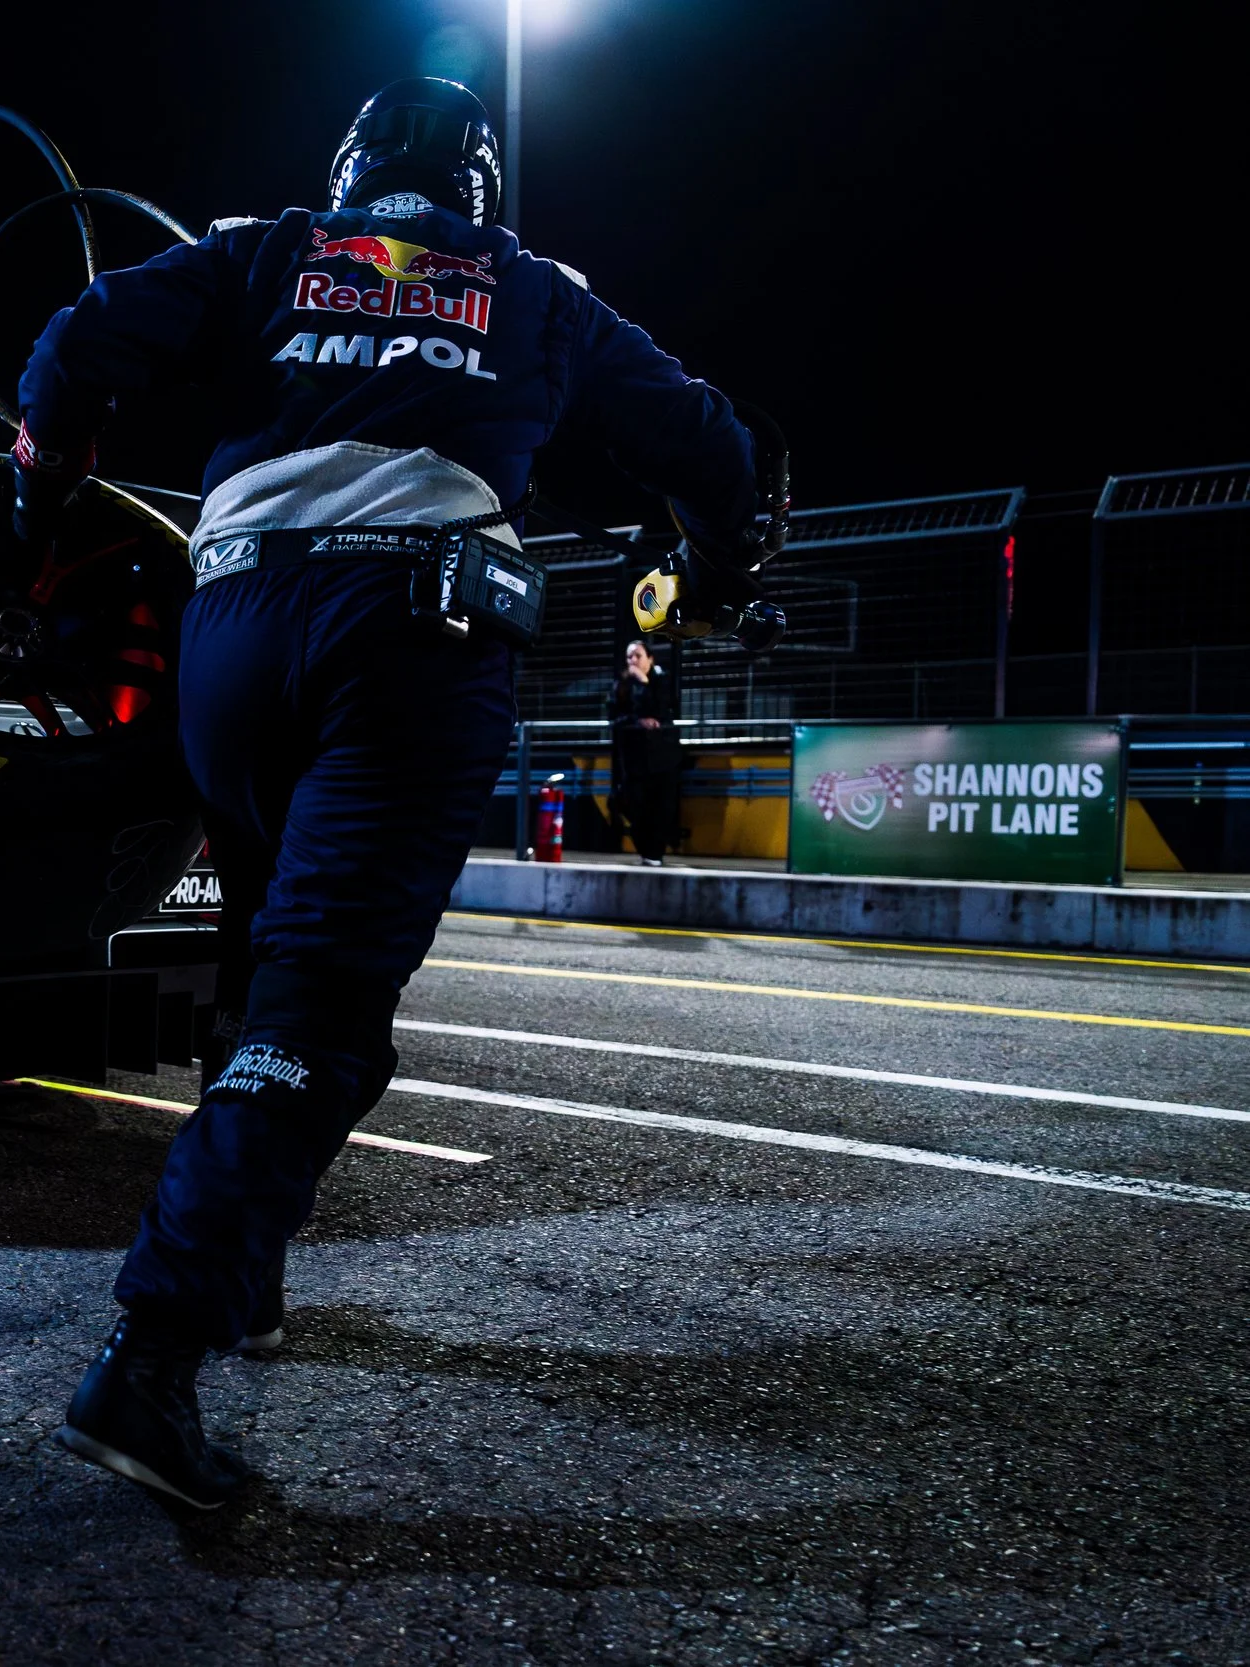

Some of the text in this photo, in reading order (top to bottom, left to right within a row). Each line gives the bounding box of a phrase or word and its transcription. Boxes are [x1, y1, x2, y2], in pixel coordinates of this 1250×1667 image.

[293, 272, 492, 335] Red Bull
[269, 333, 497, 381] AMPOL
[332, 543, 367, 552] RACE
[335, 534, 399, 544] TRIPLE
[227, 557, 254, 572] WEAR
[913, 762, 1104, 798] SHANNONS
[928, 802, 1080, 836] PIT LANE
